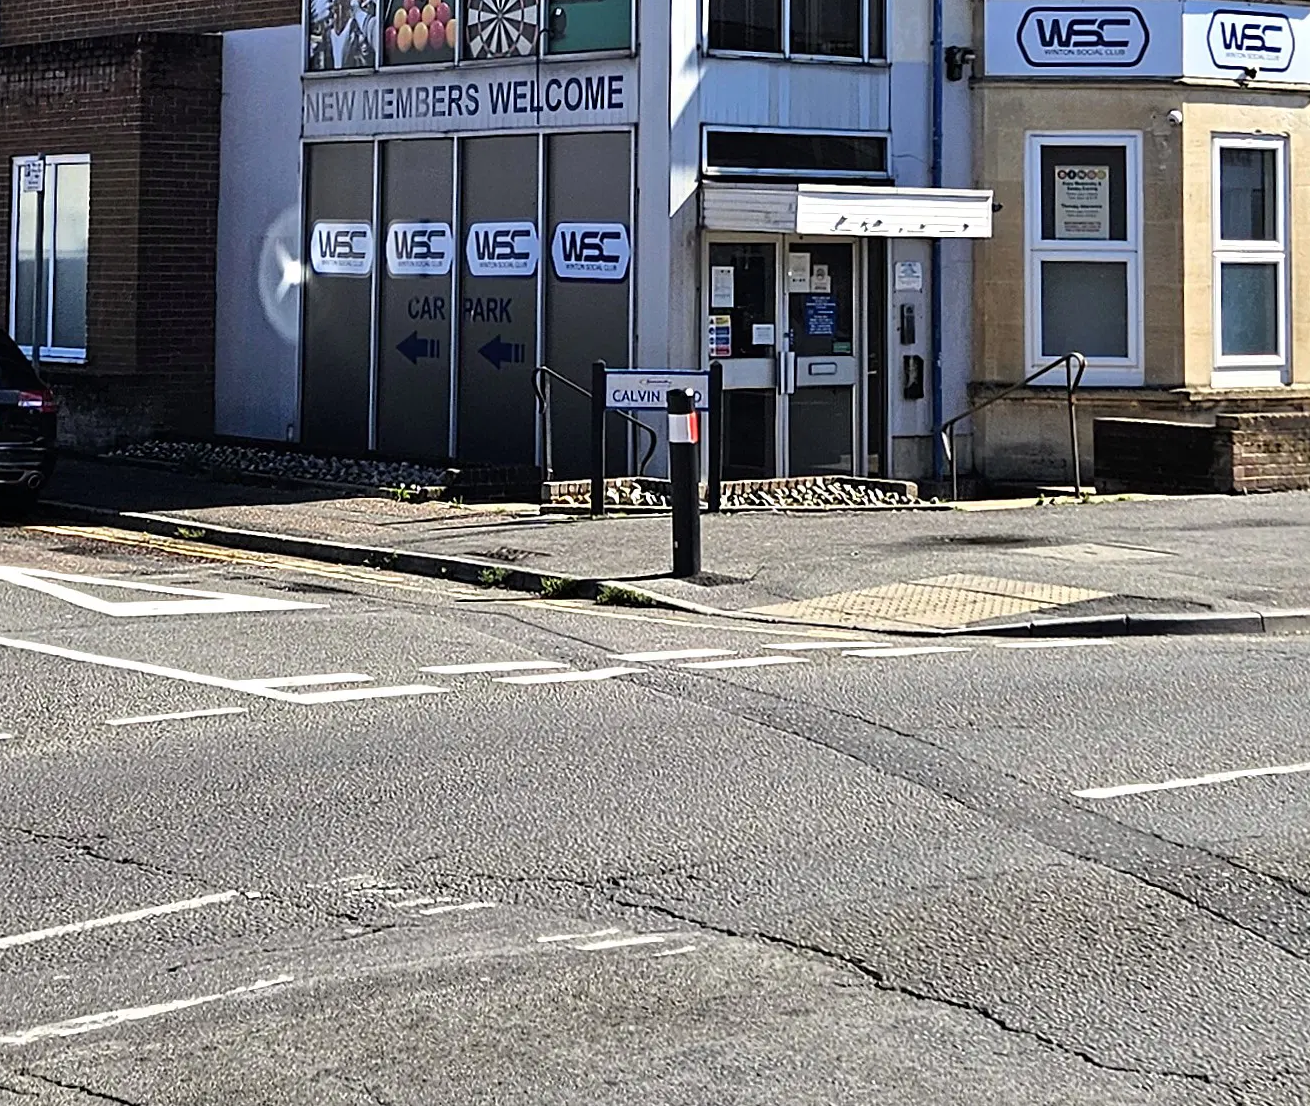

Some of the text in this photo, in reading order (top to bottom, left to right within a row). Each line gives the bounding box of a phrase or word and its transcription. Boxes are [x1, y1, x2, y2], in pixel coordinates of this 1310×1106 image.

[1036, 18, 1131, 48] WSC
[1220, 21, 1283, 53] WSC
[1044, 49, 1075, 57] WINTON
[1076, 49, 1104, 57] SOCIAL
[306, 75, 624, 123] NEW MEMBERS WELCOME
[318, 230, 367, 259] WSC
[394, 230, 446, 259] WSC
[474, 230, 531, 260] WSC
[561, 231, 621, 263] WSC
[408, 296, 512, 323] CAR PARK
[612, 390, 660, 403] CALVIN
